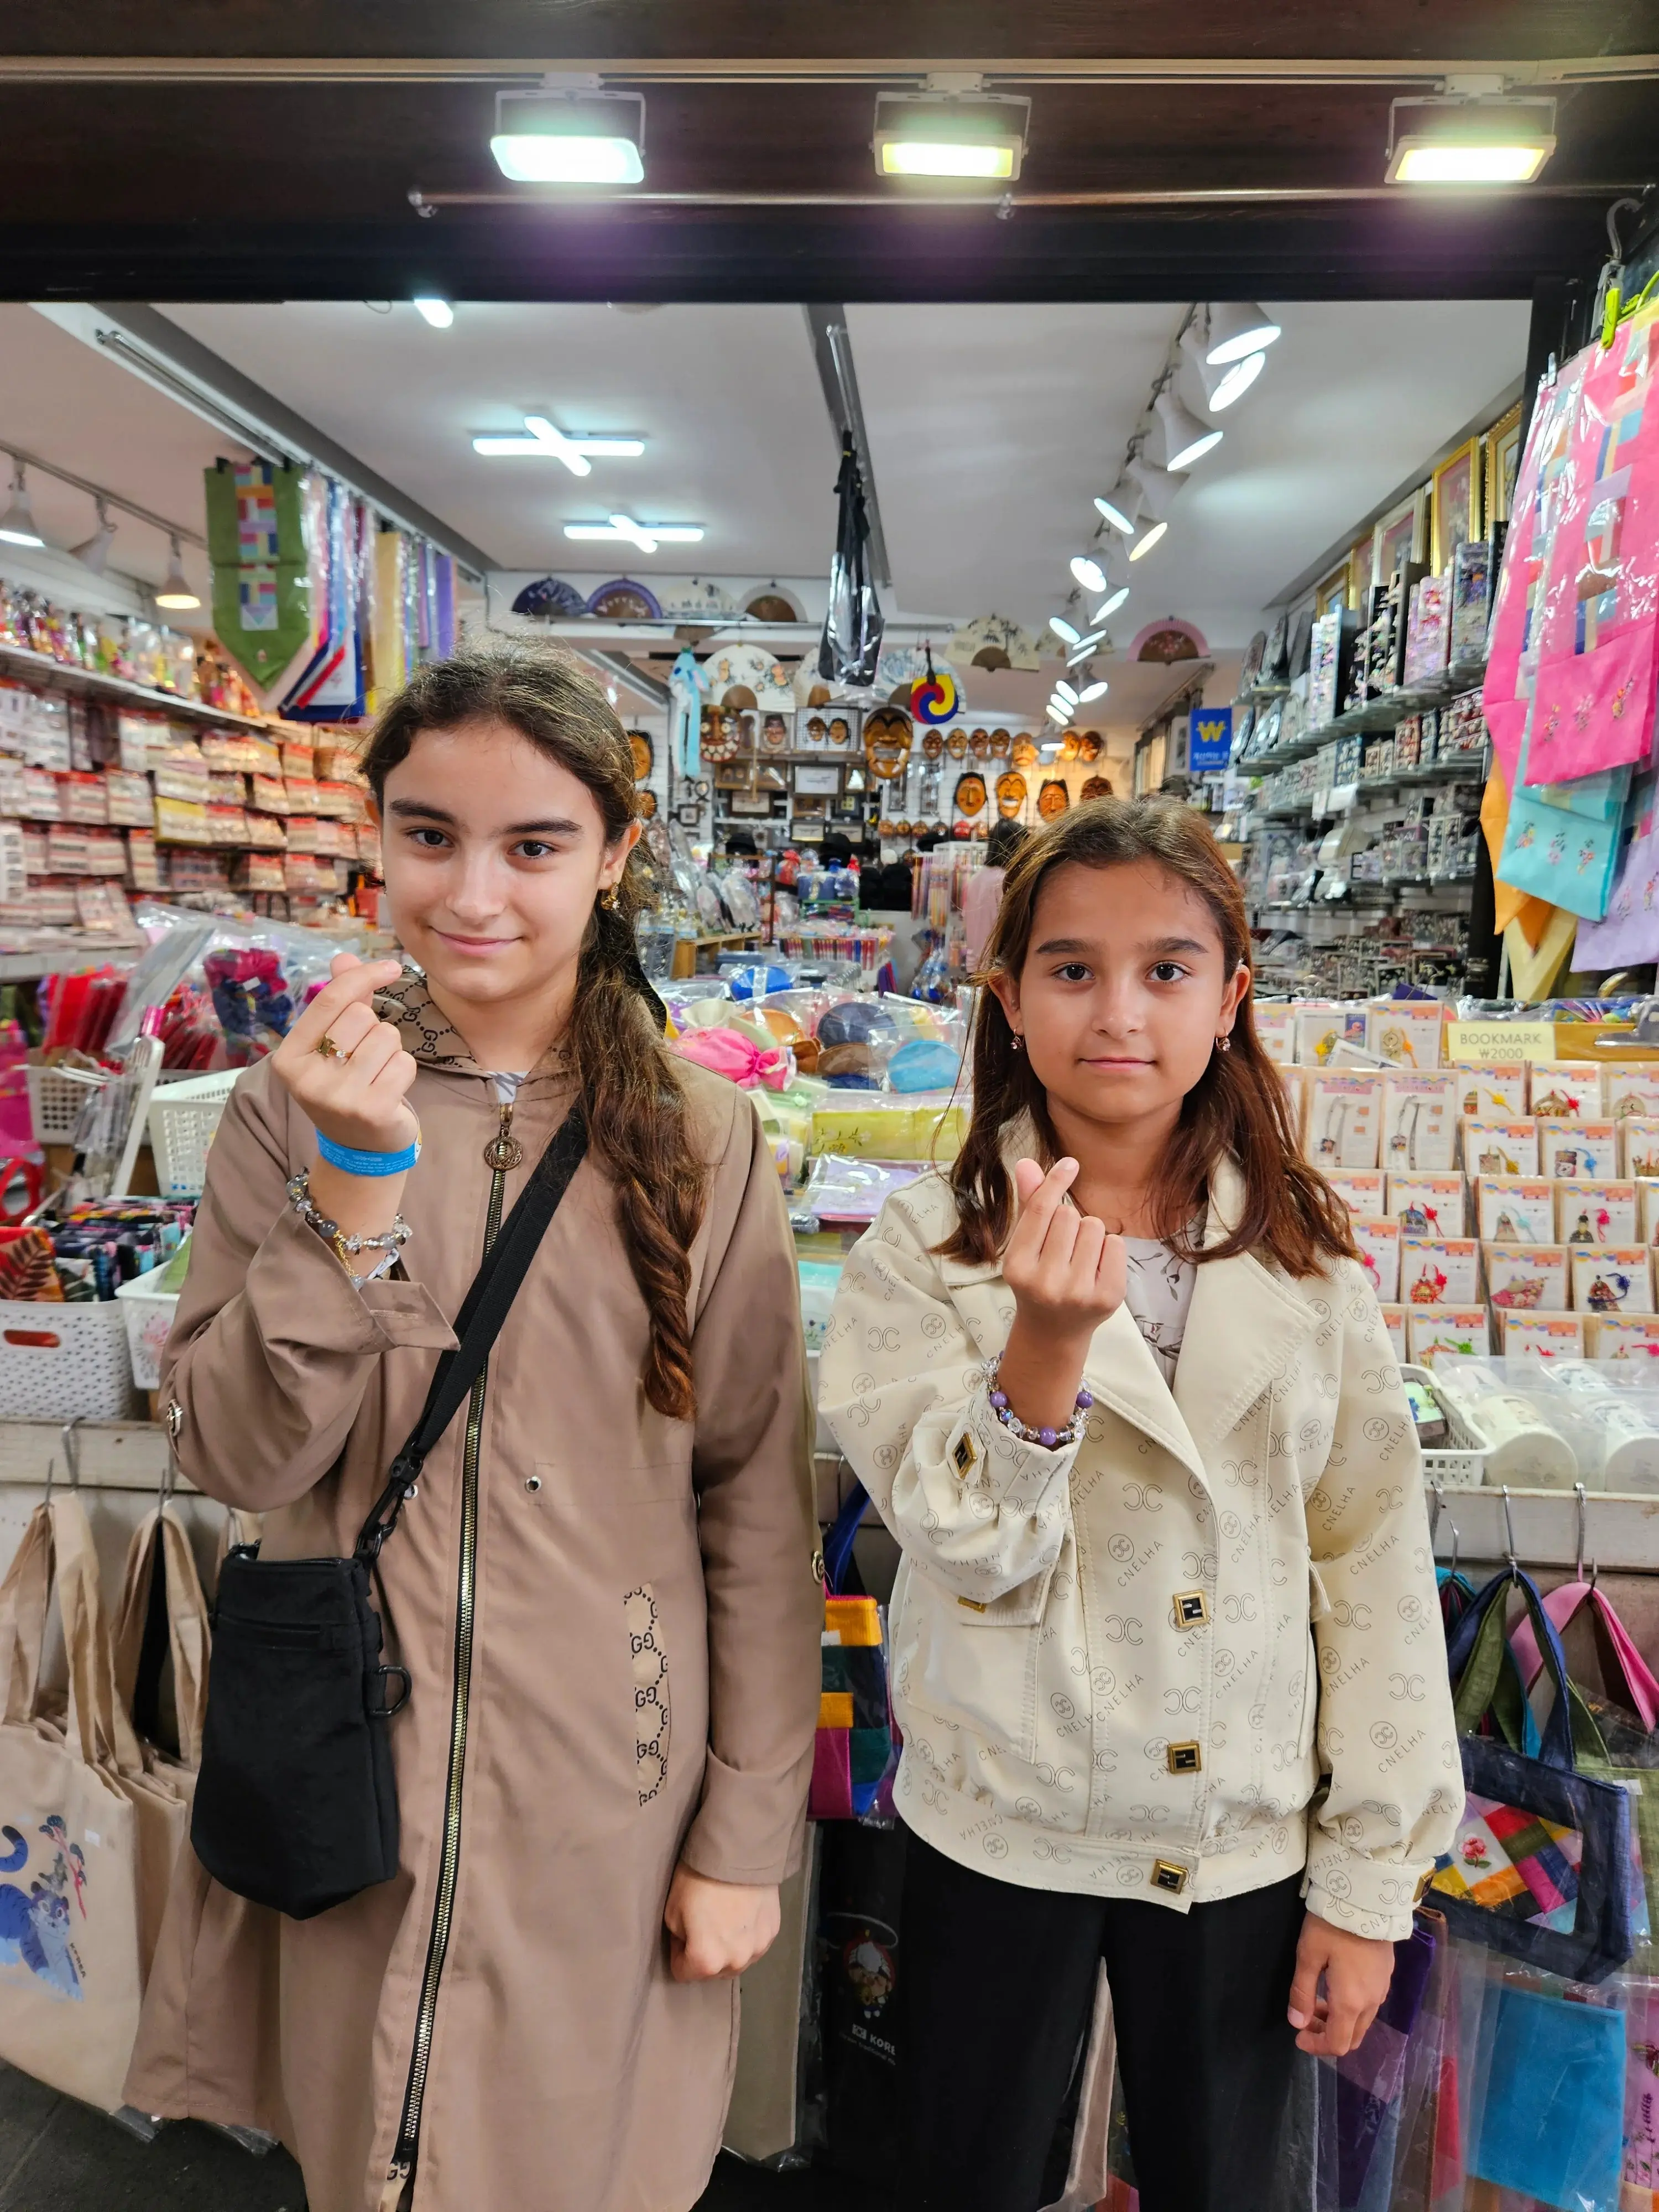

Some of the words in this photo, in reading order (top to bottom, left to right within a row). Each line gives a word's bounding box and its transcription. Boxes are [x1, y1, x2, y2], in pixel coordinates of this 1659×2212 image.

[1460, 1033, 1542, 1044] BOOKMARK
[1379, 1414, 1412, 1461] CNELHA
[1322, 1486, 1356, 1531] CNELHA
[1117, 1541, 1164, 1587] CNELHA
[1349, 1536, 1400, 1575] CNELHA
[1216, 1650, 1258, 1699] CNELHA
[1325, 1657, 1370, 1698] CNELHA
[1097, 1674, 1144, 1721] CNELHA
[1378, 1729, 1427, 1773] CNELHA
